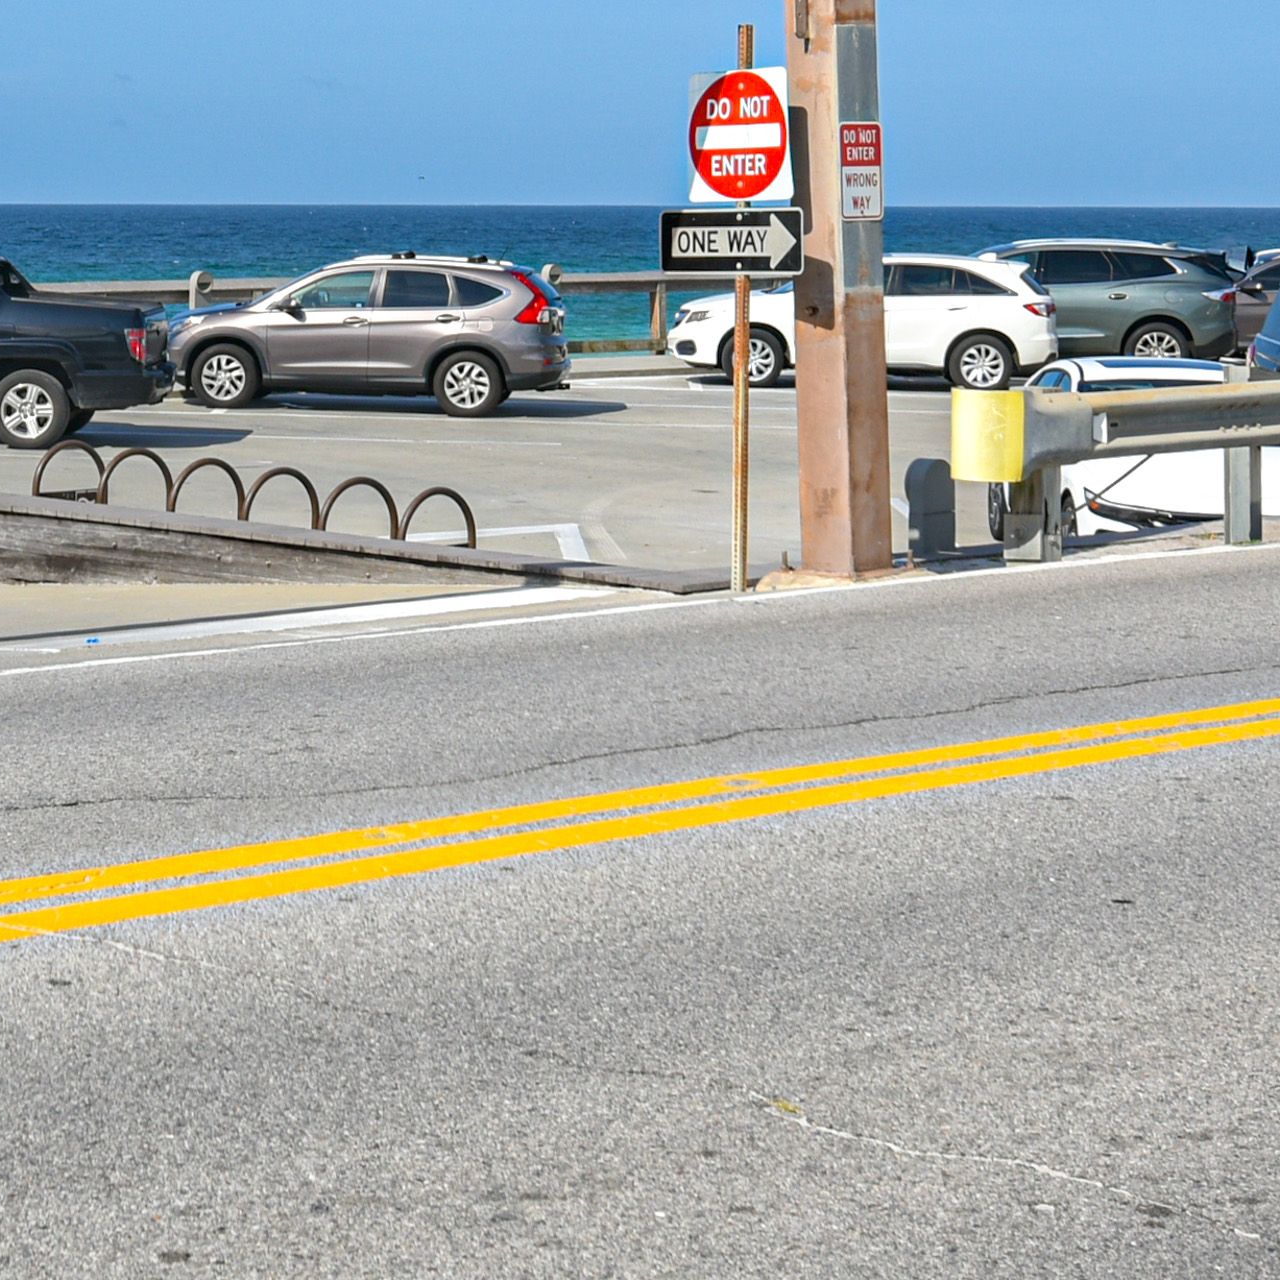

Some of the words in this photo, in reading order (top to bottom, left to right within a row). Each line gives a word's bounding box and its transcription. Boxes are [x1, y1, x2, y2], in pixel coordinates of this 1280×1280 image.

[706, 97, 731, 120] DO
[739, 95, 770, 119] NOT
[843, 129, 856, 143] DO
[859, 128, 876, 143] NOT
[846, 146, 875, 161] ENTER
[710, 153, 767, 177] ENTER
[845, 172, 878, 187] WRONG
[851, 195, 871, 209] WAY
[677, 229, 719, 253] ONE
[727, 229, 768, 253] WAY
